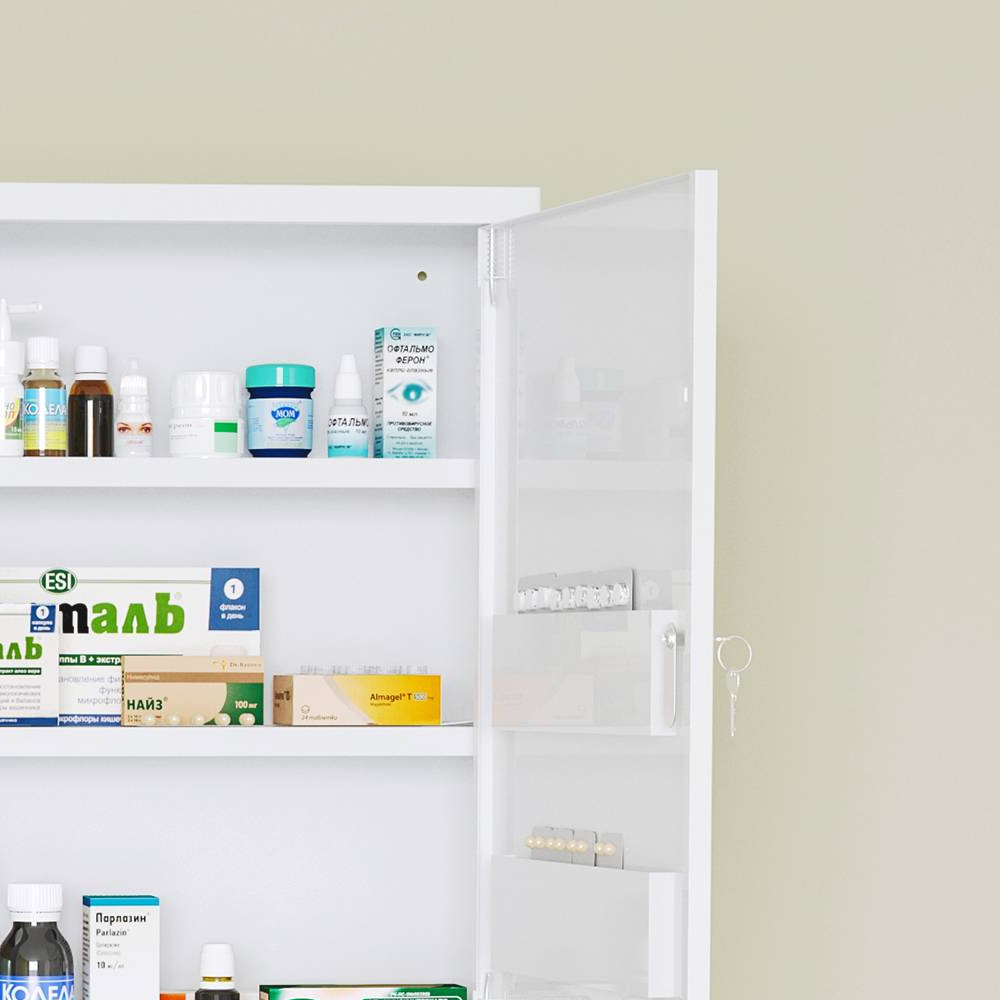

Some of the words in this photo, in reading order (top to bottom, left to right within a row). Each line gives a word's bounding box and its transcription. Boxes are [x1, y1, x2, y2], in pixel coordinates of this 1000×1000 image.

[387, 345, 435, 353] ОФТАЛЬМО
[45, 572, 72, 590] ESI
[127, 697, 163, 710] НАЙЗ
[234, 700, 248, 709] 100
[96, 912, 147, 925] Парлазин
[96, 928, 127, 936] Parlazin
[97, 961, 106, 969] 10
